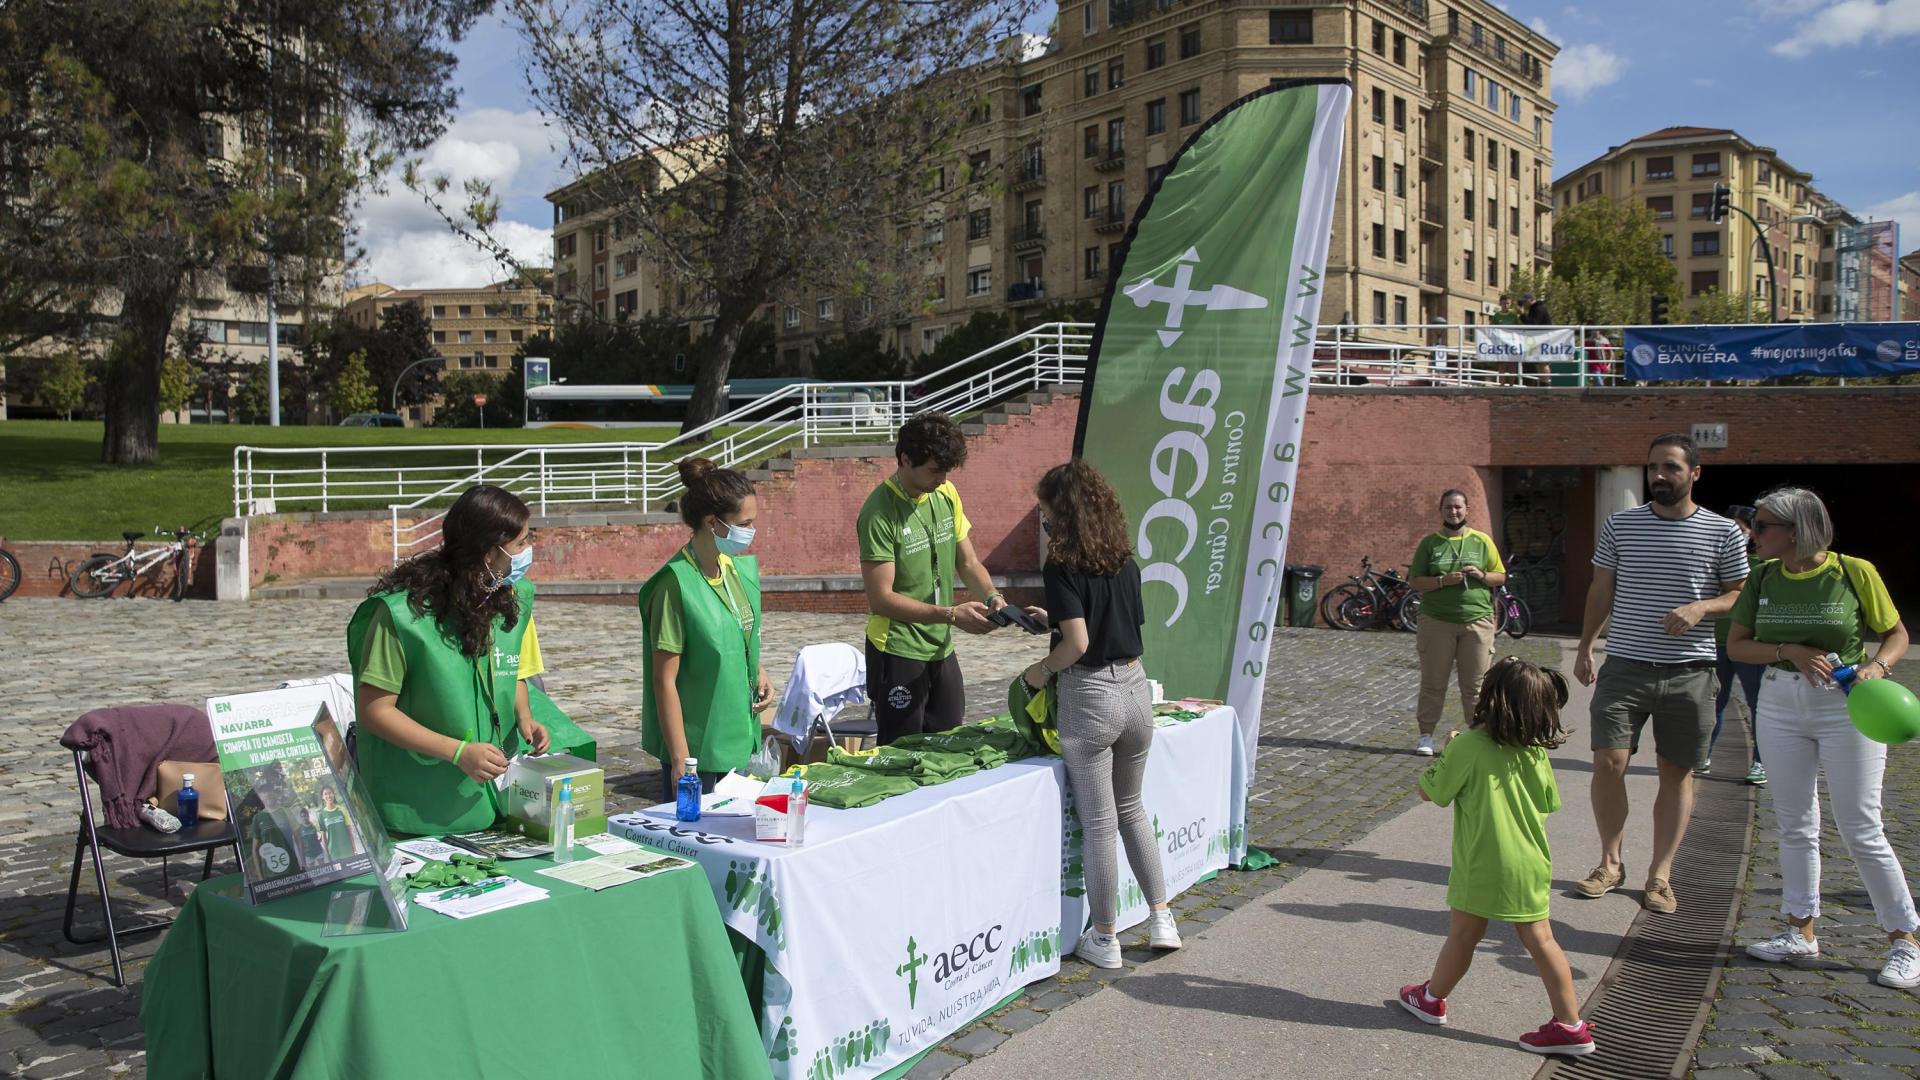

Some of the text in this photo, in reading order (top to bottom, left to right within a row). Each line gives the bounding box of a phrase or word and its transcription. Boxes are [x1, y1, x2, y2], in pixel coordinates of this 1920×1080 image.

[1478, 342, 1574, 356] Castel Ruiz
[1657, 343, 1717, 352] CLINICA
[1751, 343, 1857, 363] #mejorsingafas
[1657, 352, 1739, 364] BAVIERA
[1820, 606, 1844, 614] 2021
[215, 702, 232, 713] EN
[220, 719, 273, 734] NAVARRA
[223, 739, 252, 754] COMPRA
[251, 737, 262, 749] TU
[261, 733, 295, 748] CAMISETA
[259, 749, 286, 763] MARCHA
[286, 744, 310, 758] CONTRA
[519, 787, 540, 800] aecc
[625, 828, 699, 857] Contra el Cáncer
[1167, 817, 1206, 854] aecc
[270, 852, 289, 870] 5€
[933, 924, 1003, 984] aecc
[899, 1029, 911, 1046] TU
[911, 1015, 936, 1038] VIDA,
[939, 989, 983, 1022] NUESTRA
